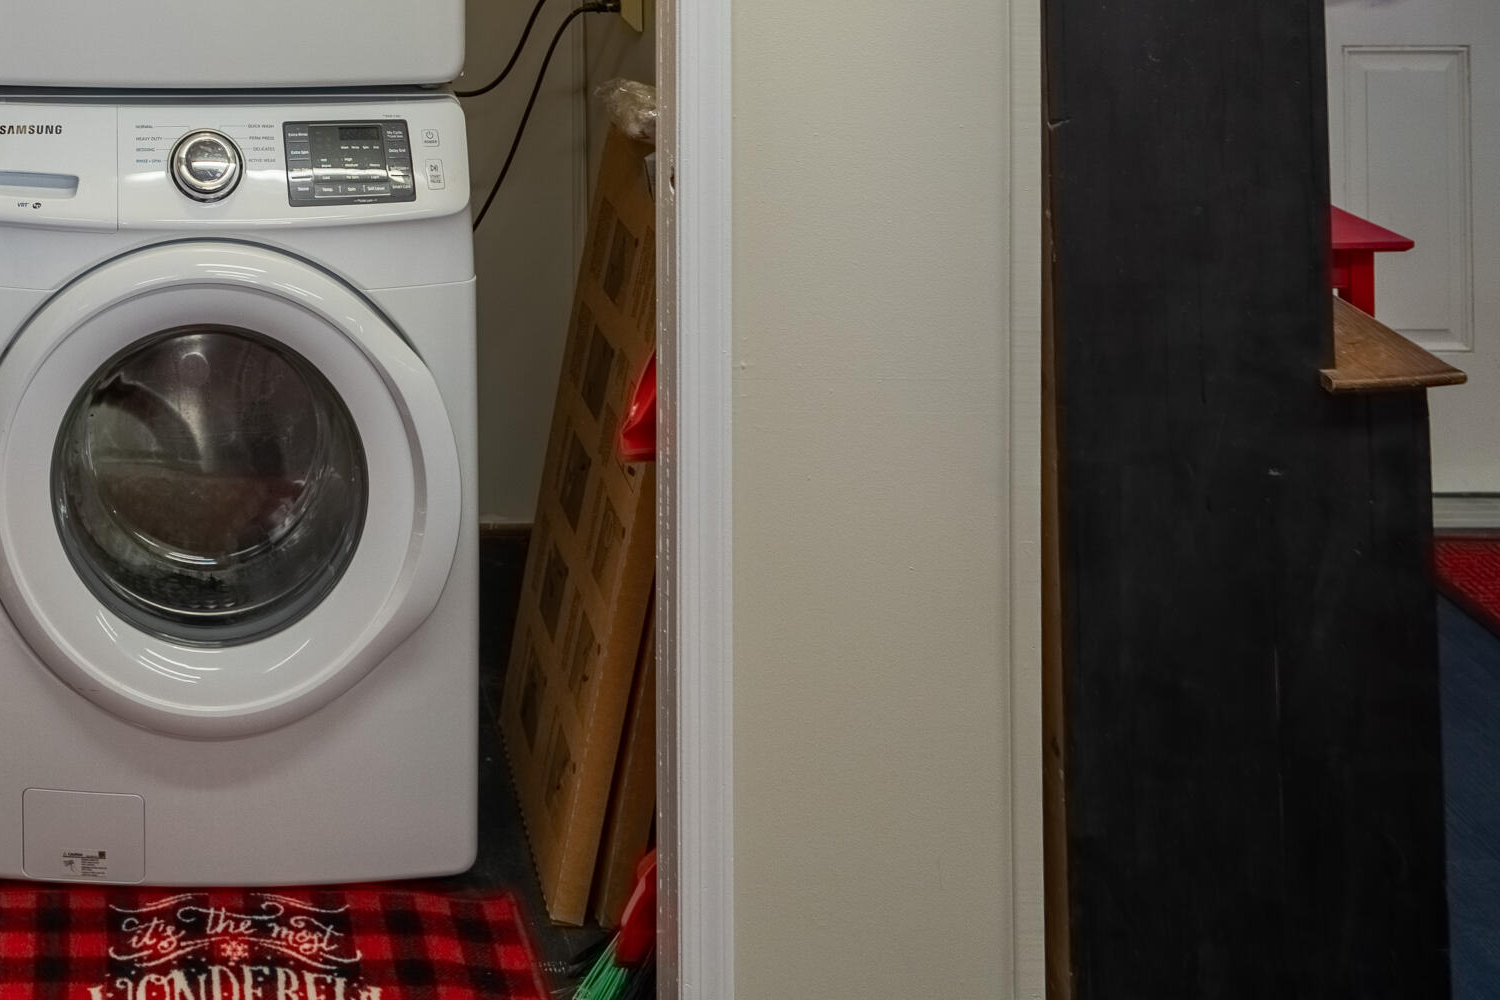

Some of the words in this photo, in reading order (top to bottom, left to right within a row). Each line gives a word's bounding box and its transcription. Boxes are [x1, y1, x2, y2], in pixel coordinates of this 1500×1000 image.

[0, 124, 63, 135] SAMSUNG
[122, 917, 186, 951] it's
[267, 915, 344, 954] most
